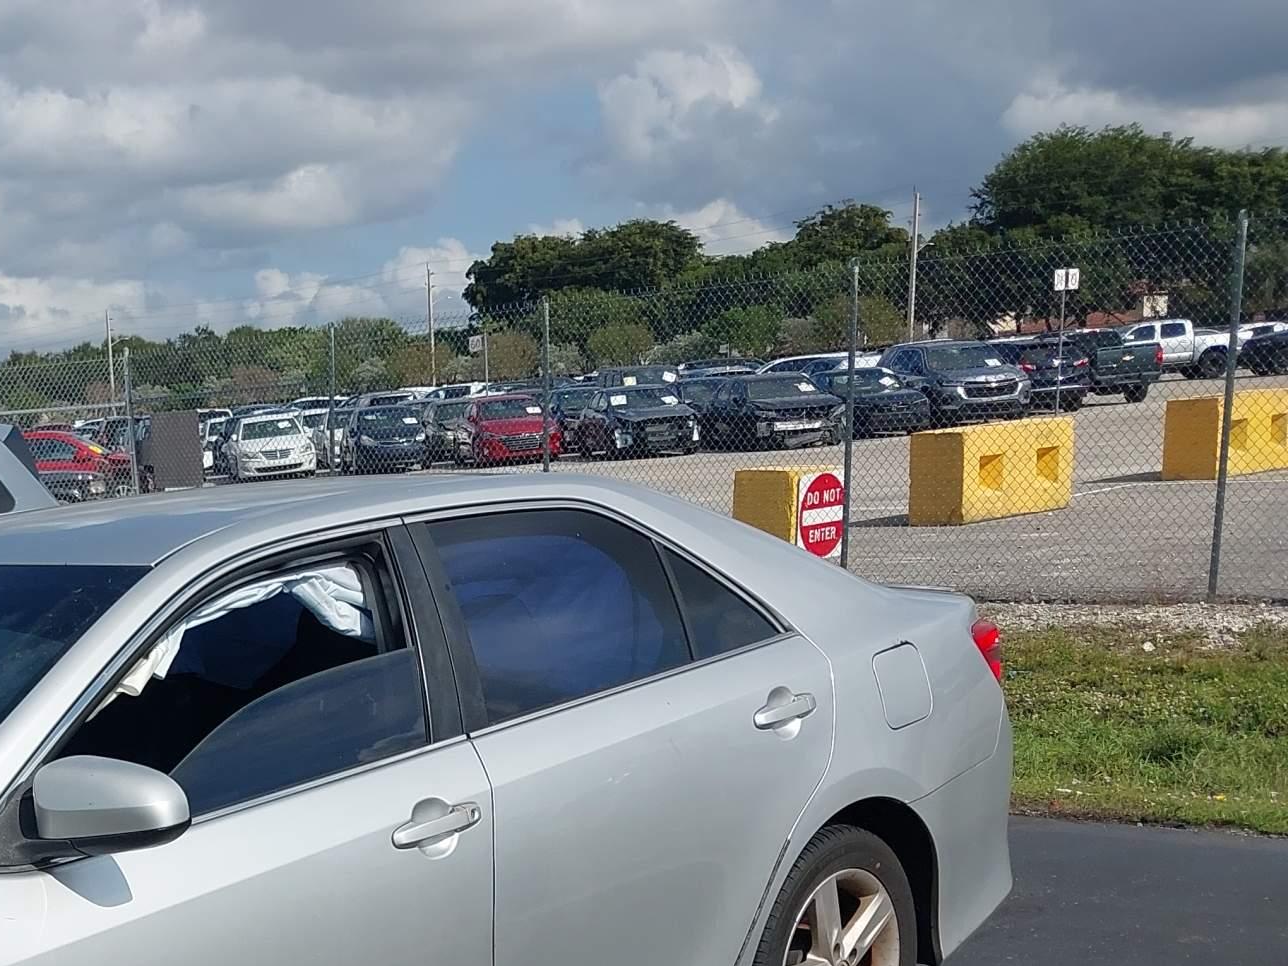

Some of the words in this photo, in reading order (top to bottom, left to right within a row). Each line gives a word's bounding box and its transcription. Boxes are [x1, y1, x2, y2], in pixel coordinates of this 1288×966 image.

[807, 491, 819, 505] DO
[823, 488, 841, 504] NOT
[809, 527, 836, 543] ENTER
